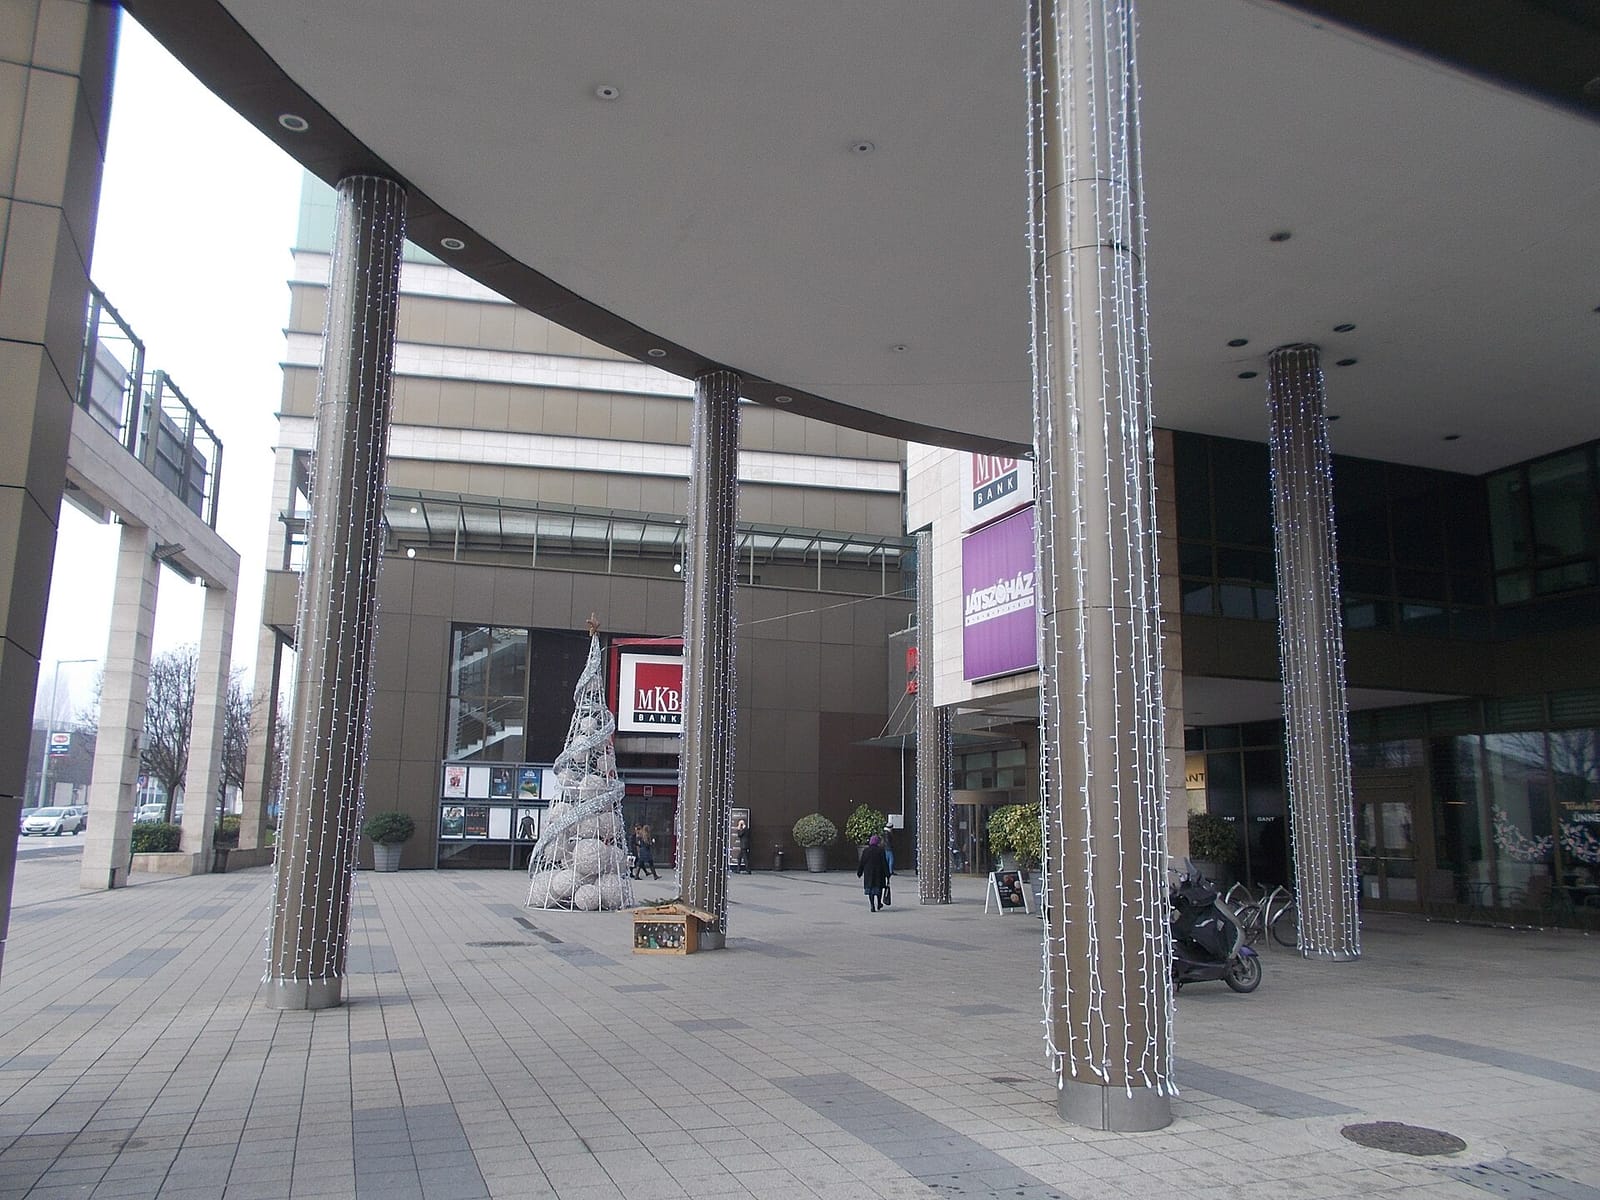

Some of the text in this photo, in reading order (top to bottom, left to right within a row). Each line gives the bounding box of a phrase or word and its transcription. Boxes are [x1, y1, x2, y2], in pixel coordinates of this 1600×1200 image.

[977, 477, 1013, 505] BANK
[965, 571, 1034, 616] JÁTSZÓHÁZ
[638, 686, 679, 712] MKB
[638, 713, 677, 723] BANK
